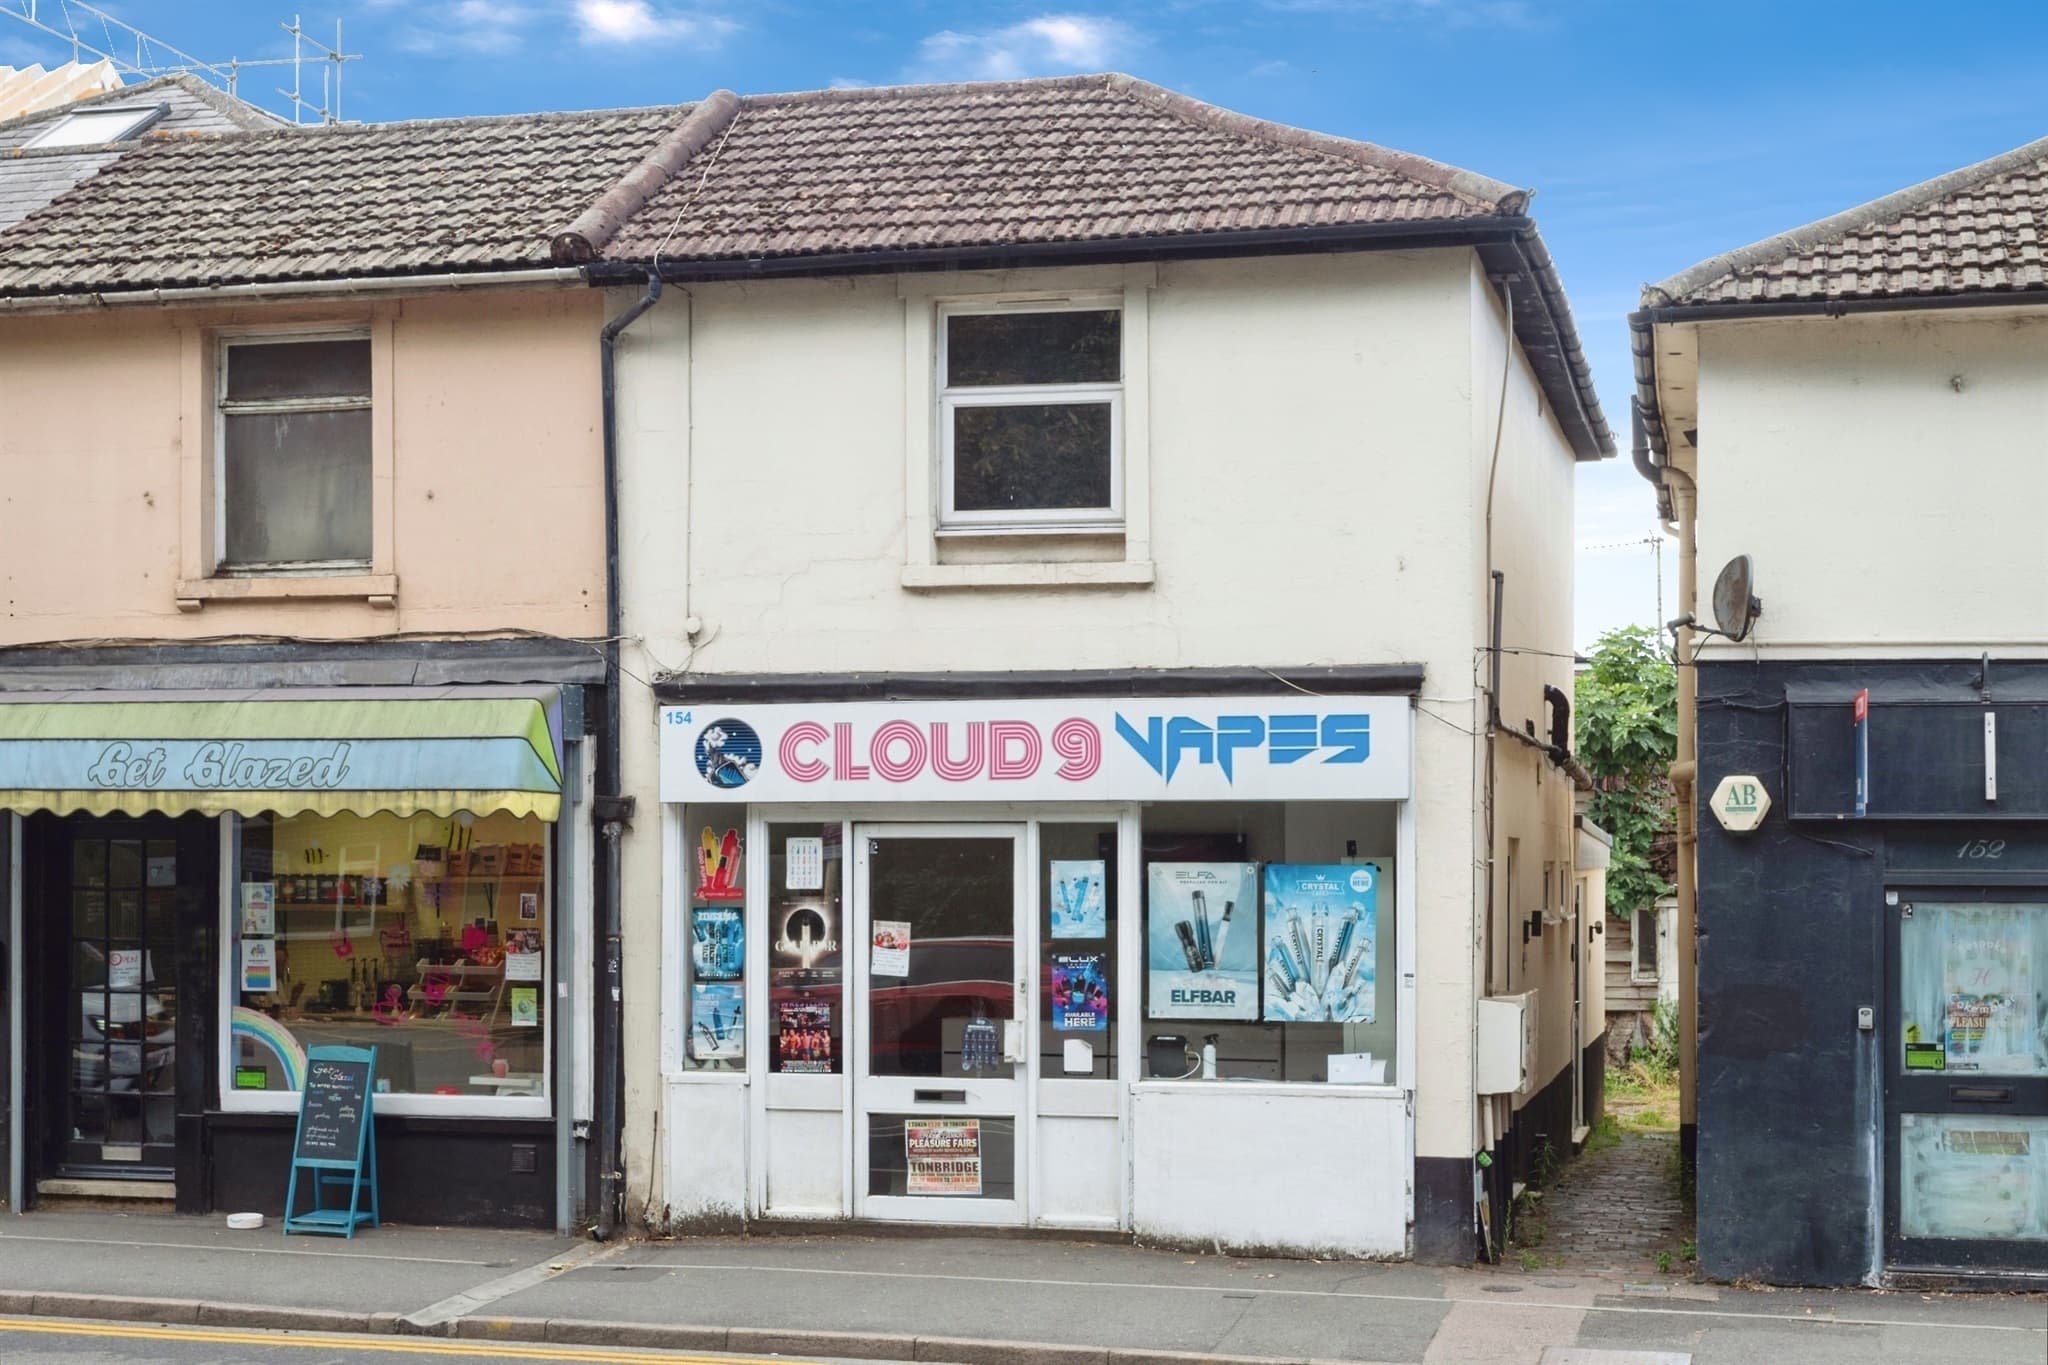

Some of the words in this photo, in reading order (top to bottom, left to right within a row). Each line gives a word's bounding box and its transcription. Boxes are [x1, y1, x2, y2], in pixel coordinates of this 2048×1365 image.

[666, 711, 692, 725] 154
[1114, 711, 1371, 788] VAPES
[88, 741, 167, 788] Get
[183, 741, 352, 789] Glazed
[1725, 783, 1757, 806] AB
[1957, 839, 2006, 859] 152
[1175, 871, 1217, 880] ELFA
[1301, 882, 1340, 891] CRYSTAL
[1316, 928, 1324, 959] CRYSTAL
[1170, 989, 1236, 1004] ELFBAR
[1064, 1017, 1097, 1027] HERE
[909, 1138, 951, 1148] PLEASURE
[952, 1138, 977, 1148] FAIRS
[910, 1161, 979, 1173] TONBRIDGE
